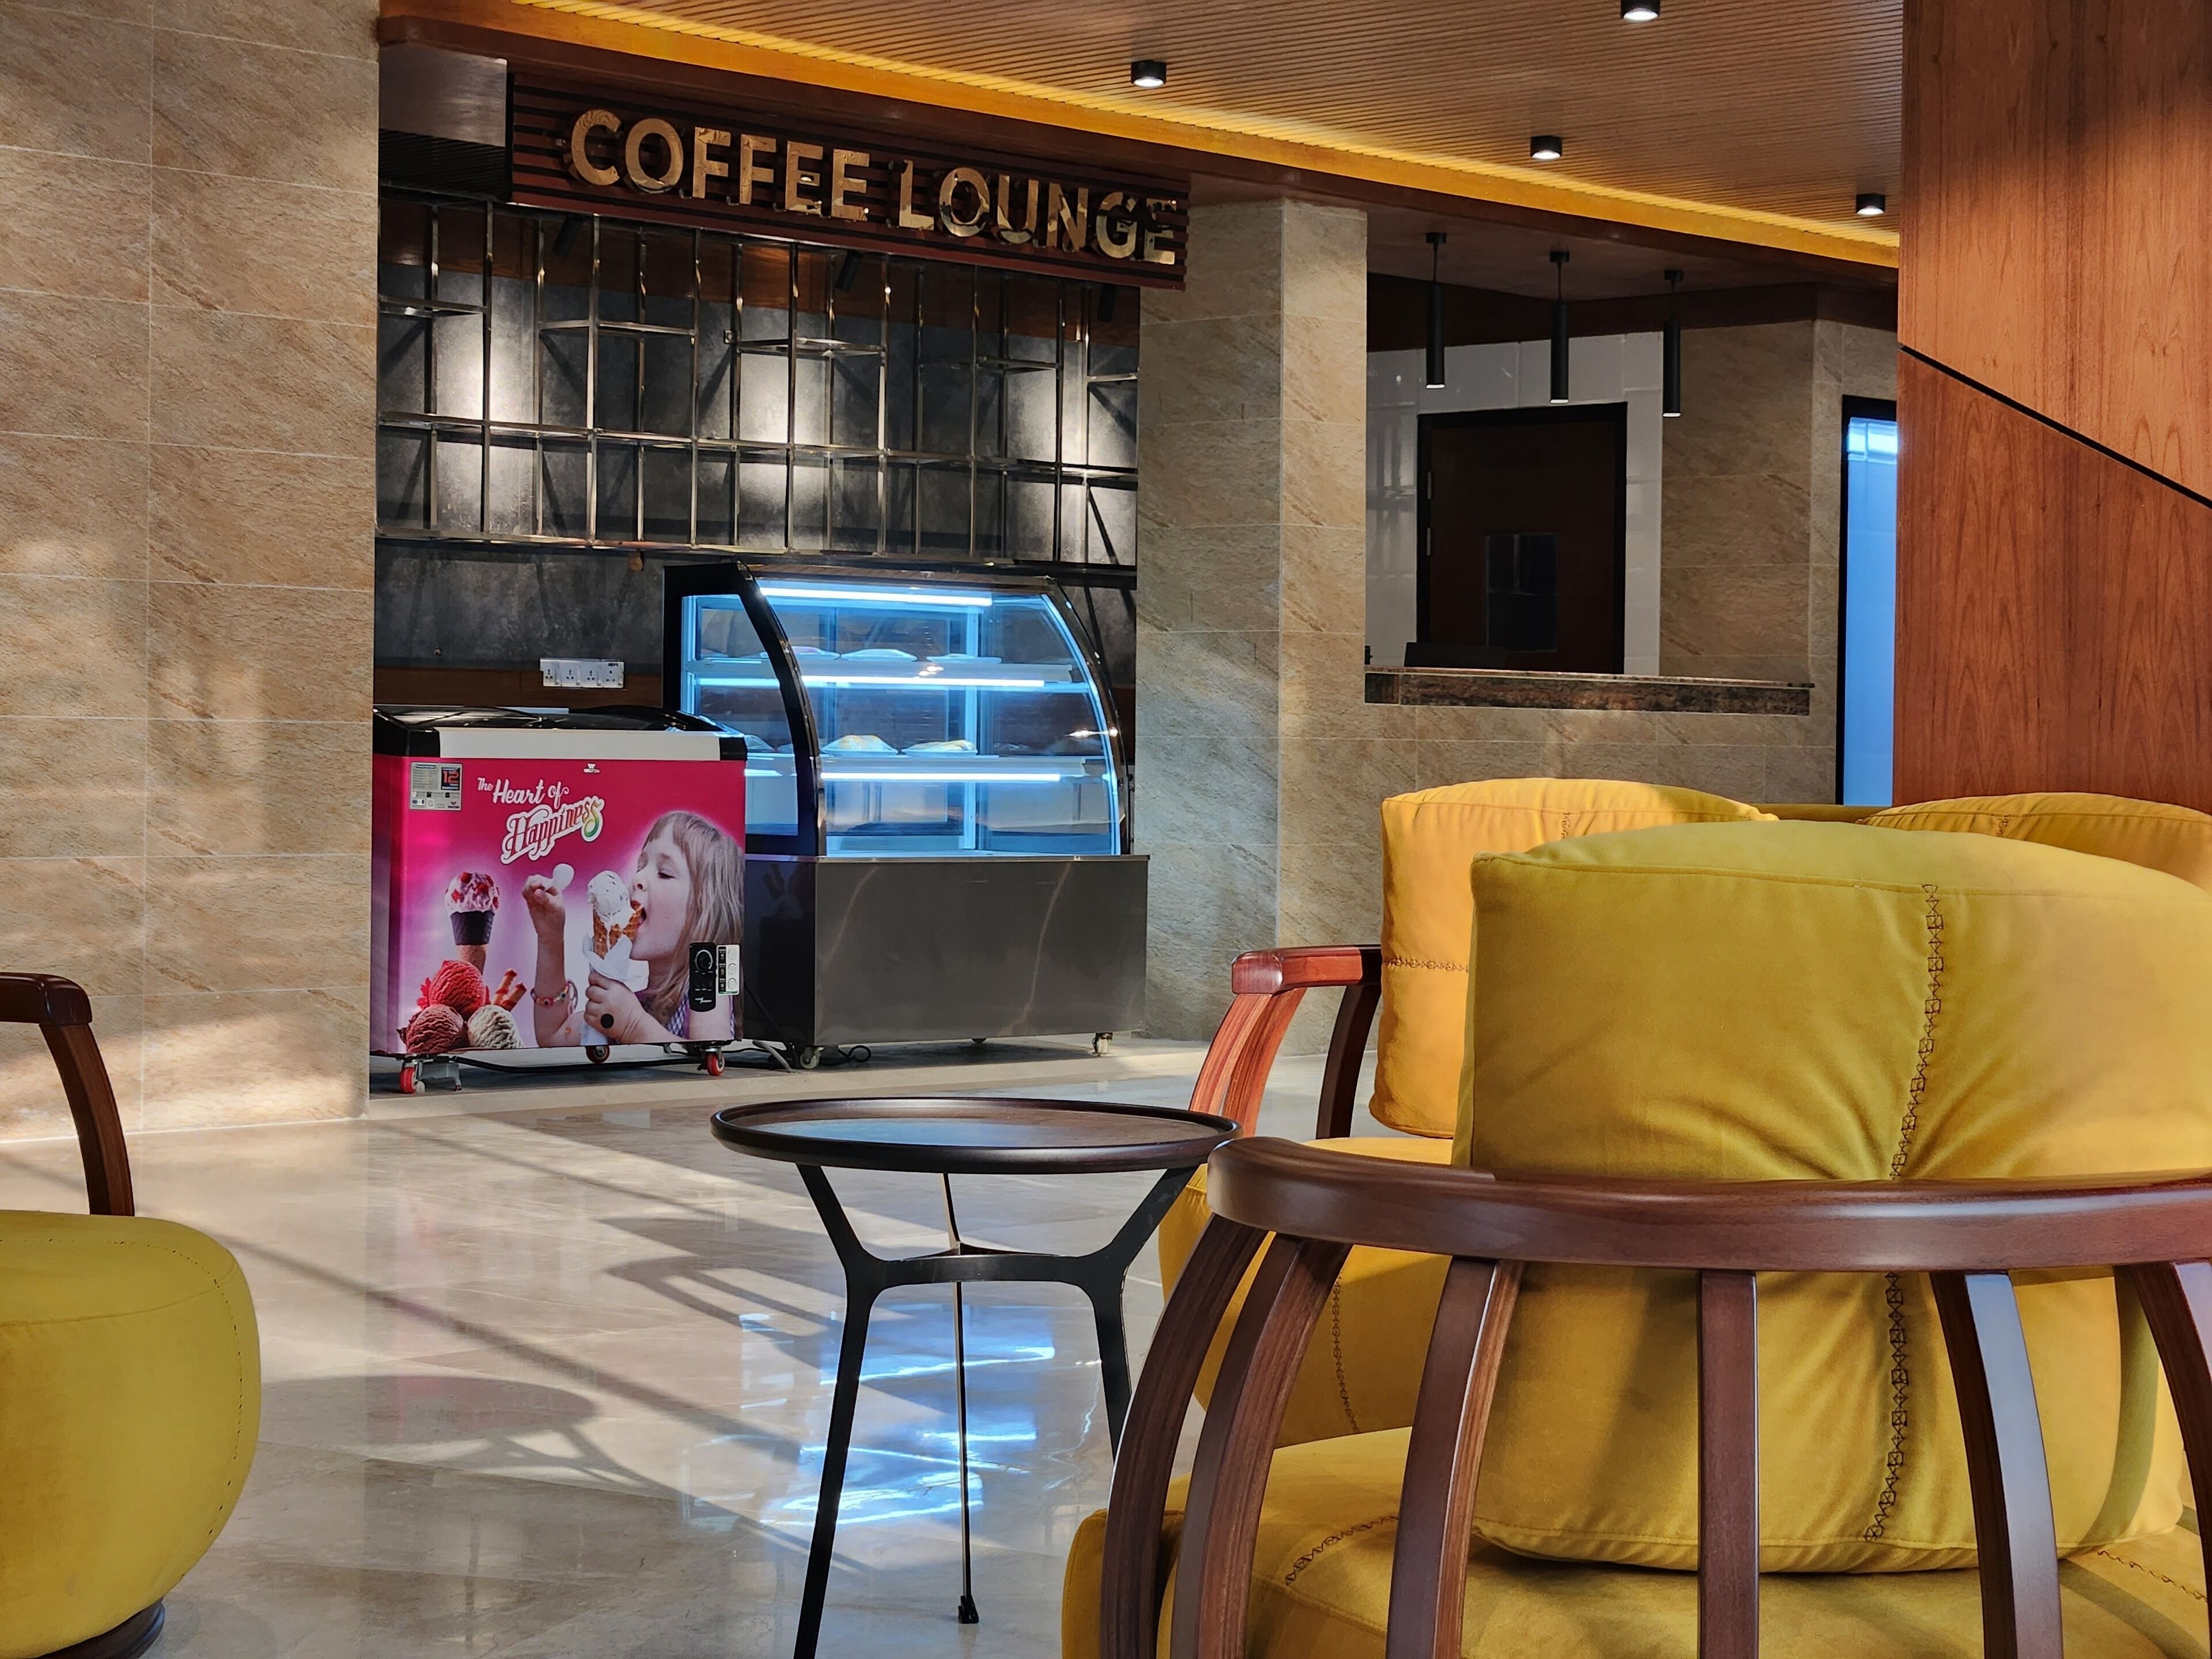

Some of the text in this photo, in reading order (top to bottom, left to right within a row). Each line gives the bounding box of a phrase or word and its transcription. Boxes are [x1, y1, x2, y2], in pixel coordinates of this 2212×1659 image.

[571, 109, 1176, 265] COFFEE LOUNGE
[478, 777, 569, 809] The Heart of
[501, 796, 604, 863] Happiness
